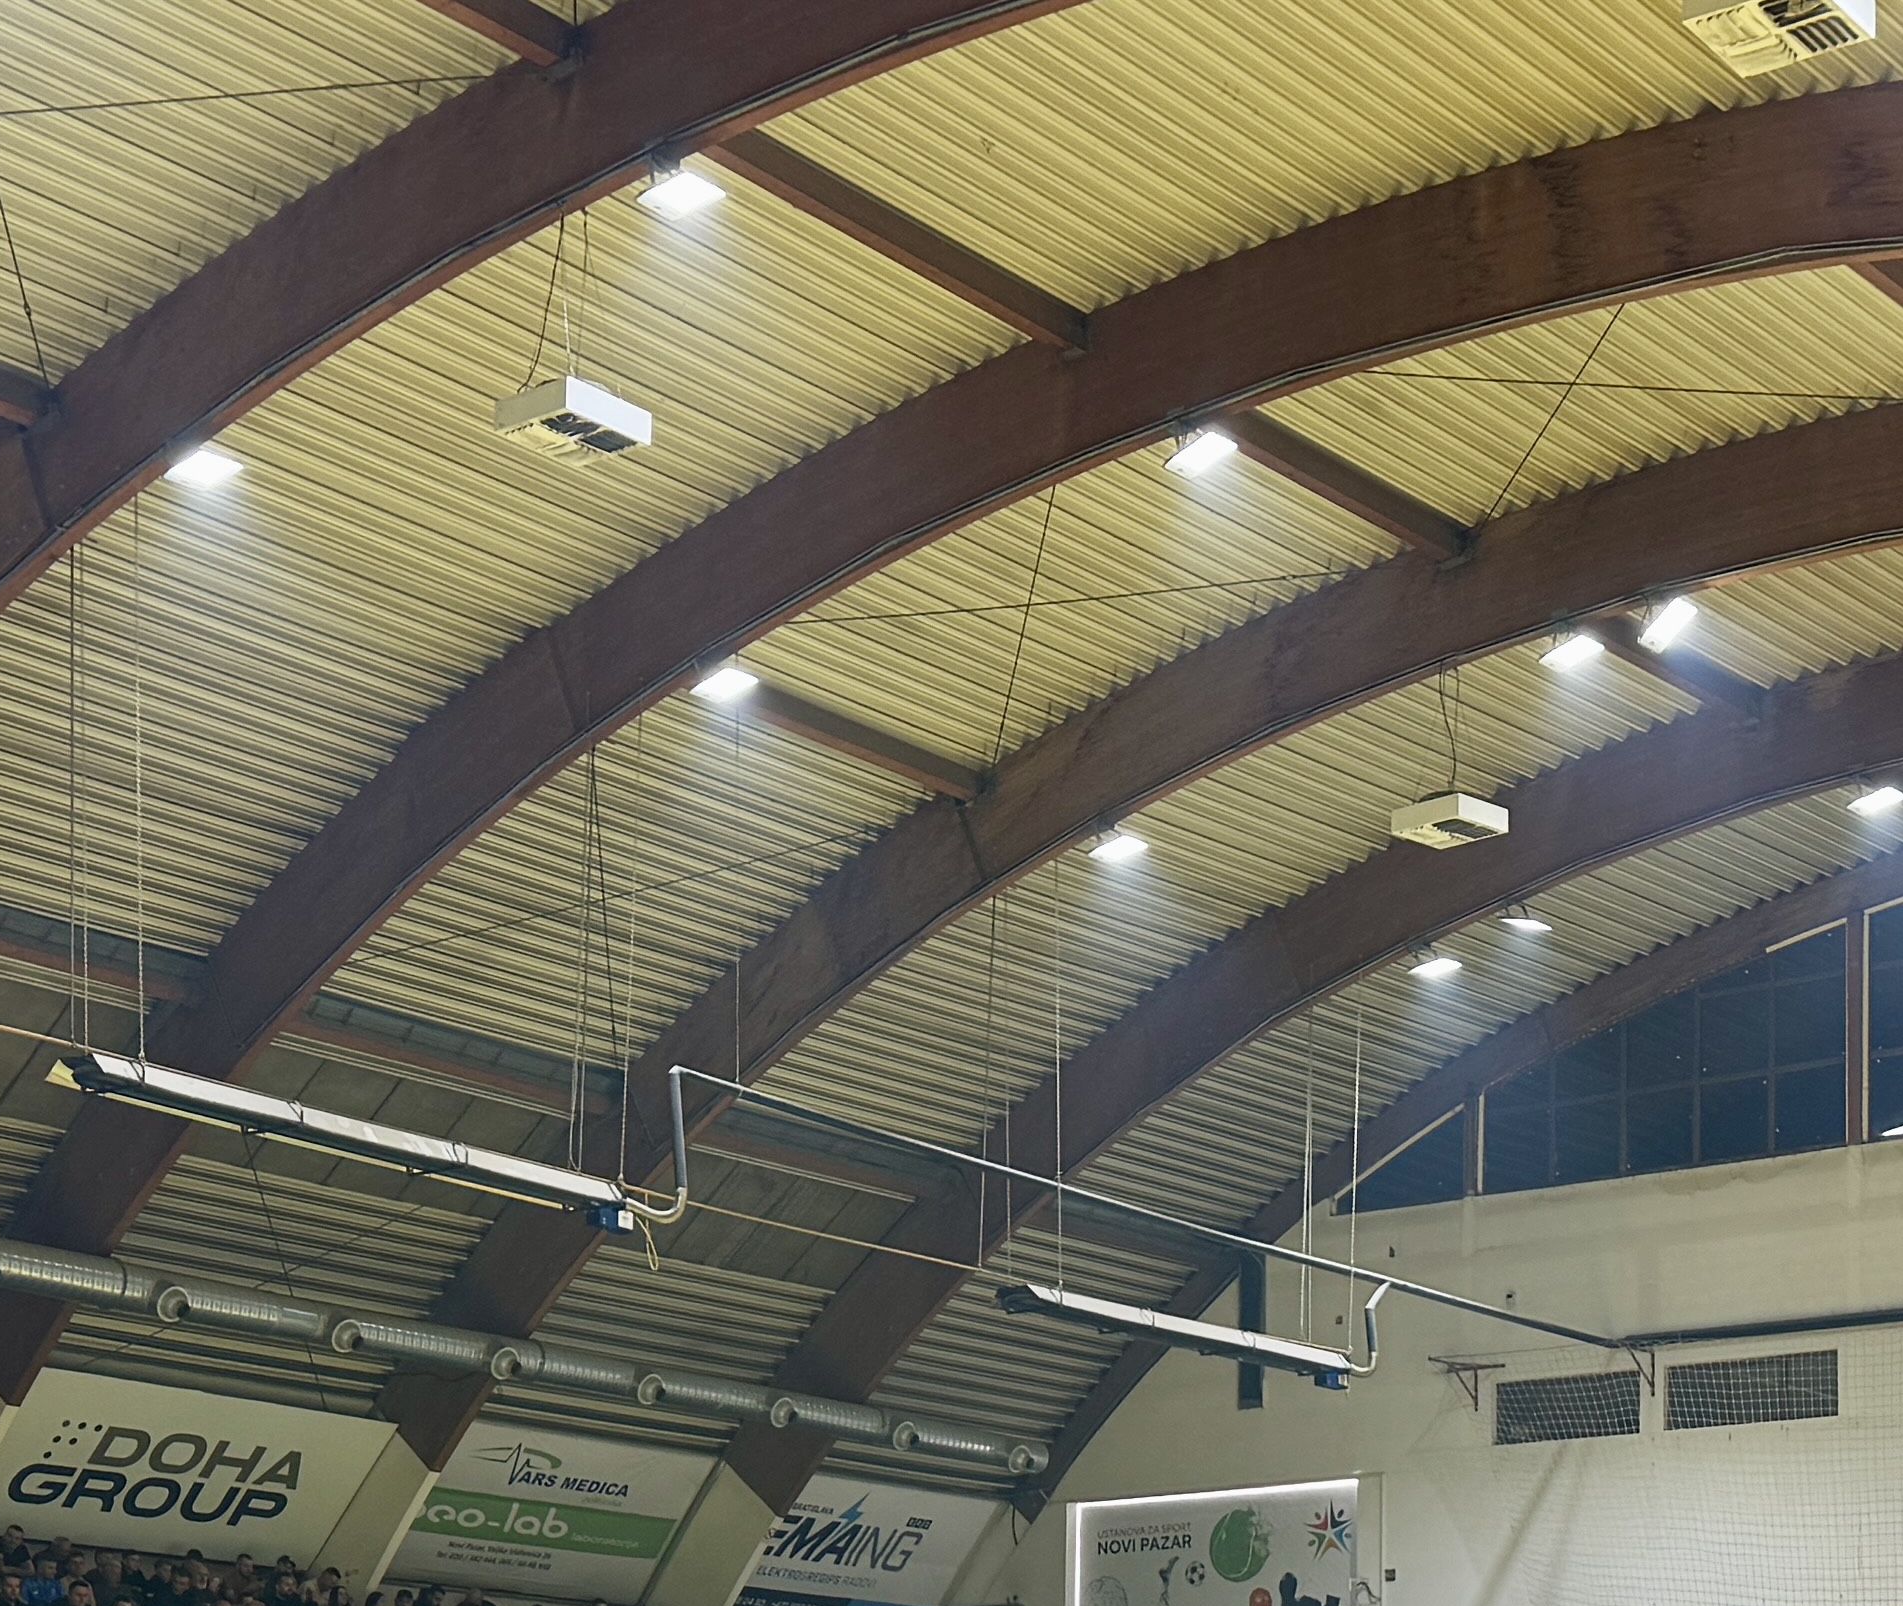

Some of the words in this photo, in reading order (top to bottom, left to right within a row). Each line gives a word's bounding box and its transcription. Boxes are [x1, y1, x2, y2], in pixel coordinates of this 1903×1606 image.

[87, 1426, 301, 1490] DOHA
[8, 1464, 288, 1526] GROUP
[560, 1476, 630, 1498] MEDICA
[1097, 1538, 1136, 1555] NOVI
[1140, 1534, 1192, 1552] PAZAR
